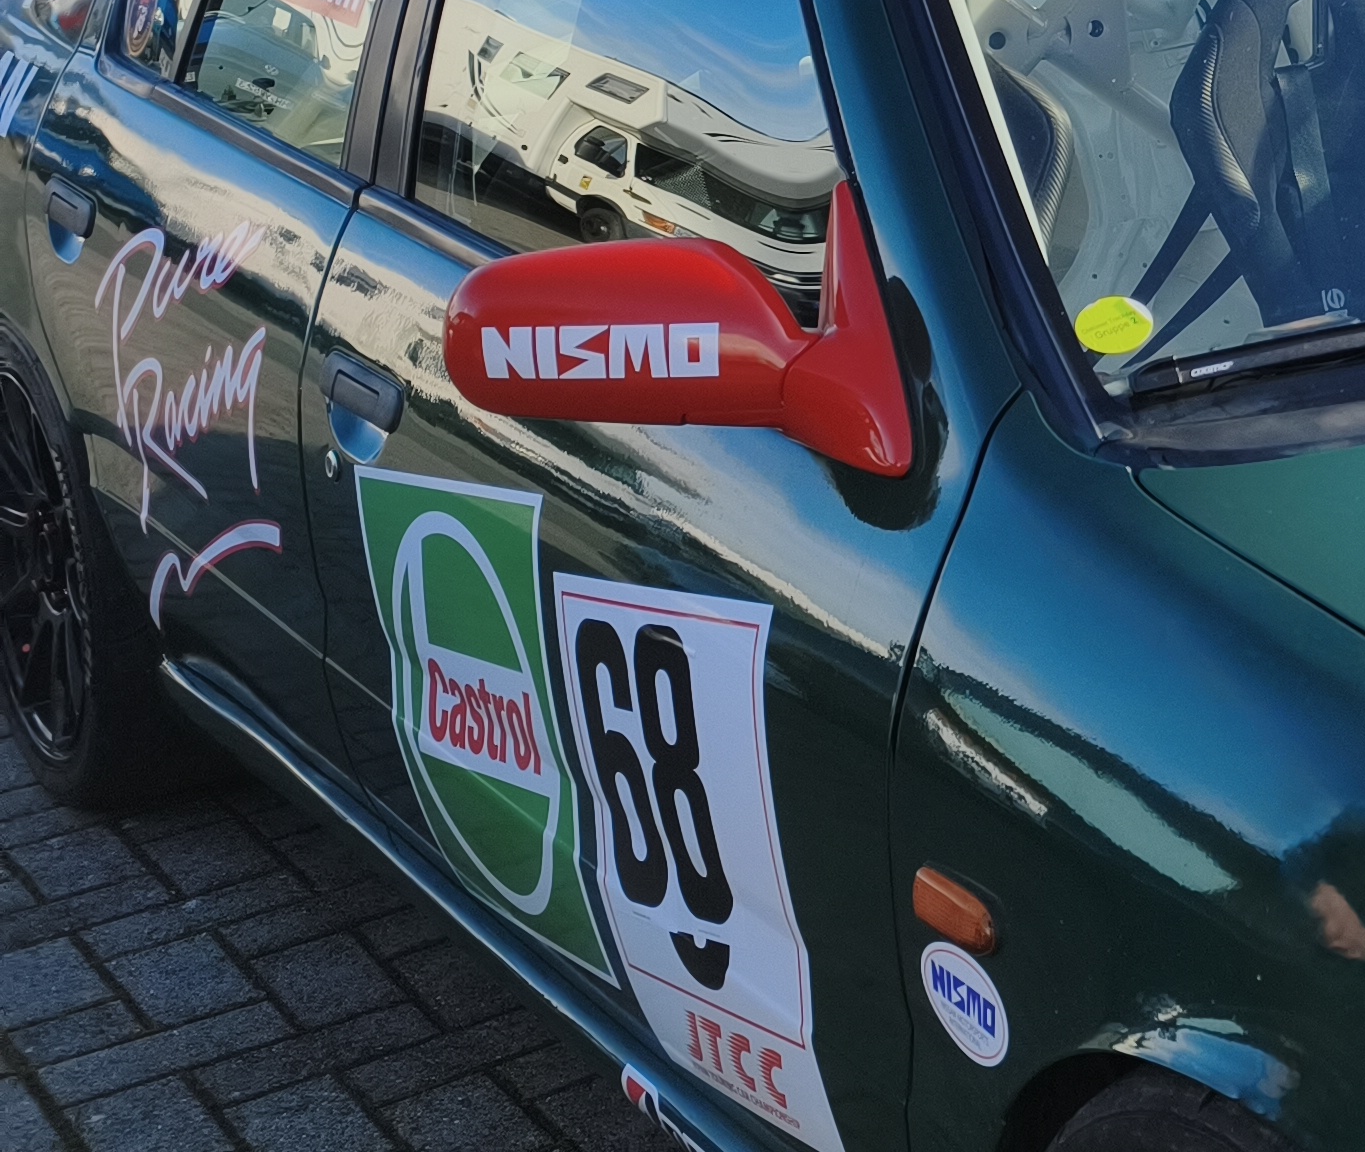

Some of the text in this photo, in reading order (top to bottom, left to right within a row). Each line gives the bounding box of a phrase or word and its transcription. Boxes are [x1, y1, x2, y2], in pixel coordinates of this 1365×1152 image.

[94, 219, 268, 446] Pure
[480, 321, 720, 380] NISMO
[122, 325, 269, 536] Racing
[427, 657, 542, 776] Castrol
[575, 617, 734, 926] 68
[930, 957, 997, 1040] NISMO
